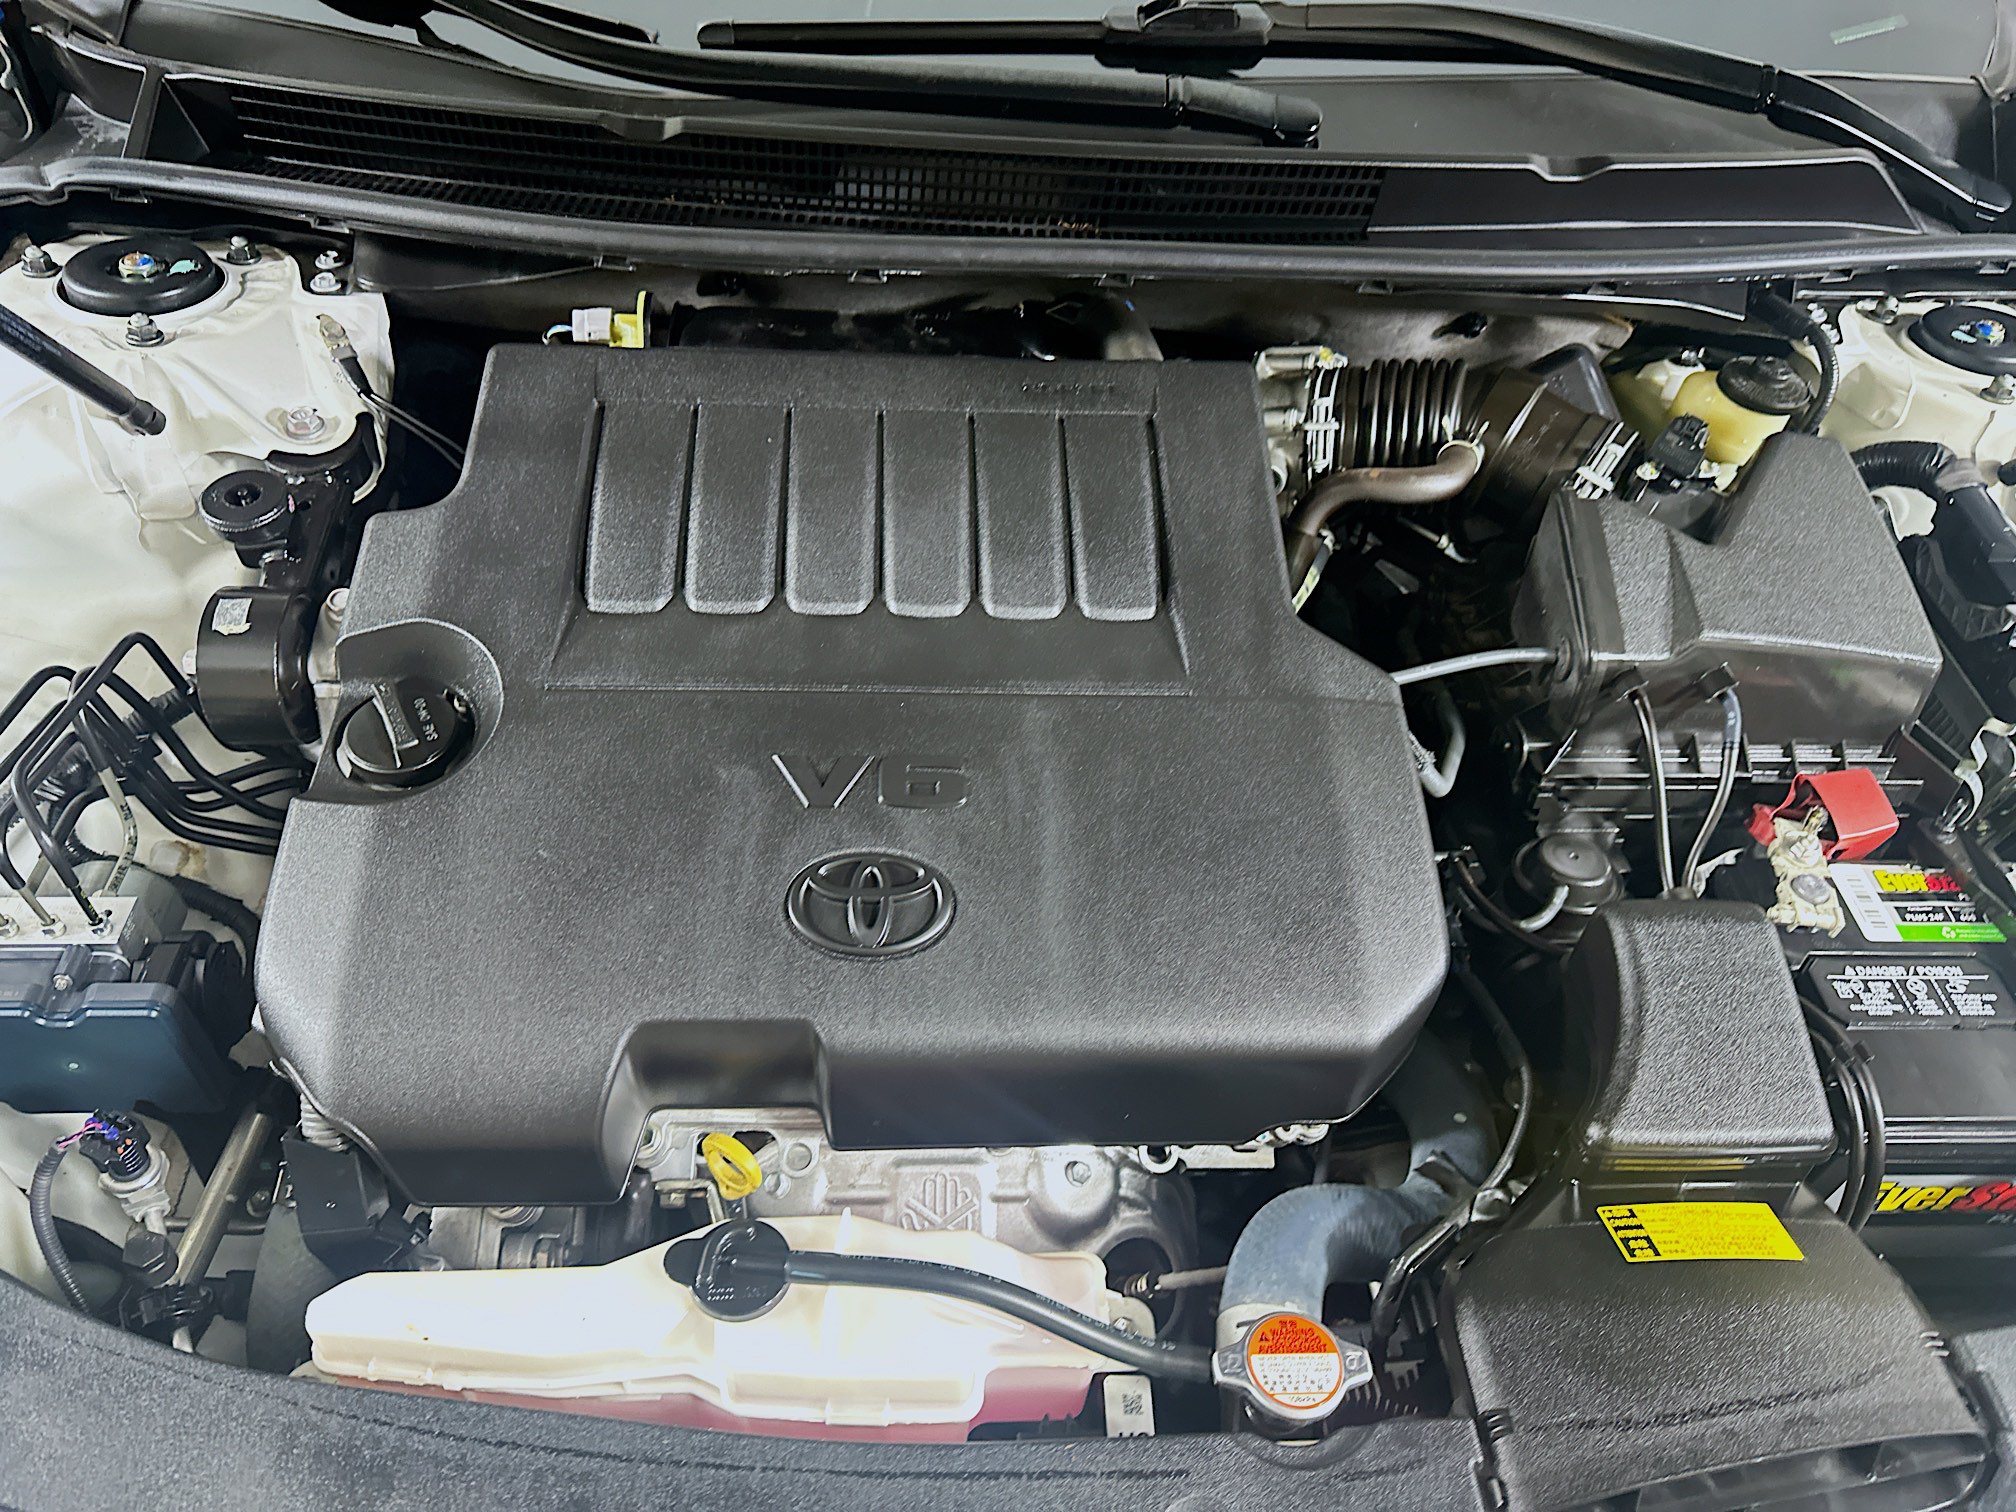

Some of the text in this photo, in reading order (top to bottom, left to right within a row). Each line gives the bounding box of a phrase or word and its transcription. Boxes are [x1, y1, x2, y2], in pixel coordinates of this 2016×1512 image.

[422, 722, 439, 741] SAE
[771, 753, 969, 809] V6
[1855, 965, 1907, 976] DANGER
[1915, 965, 1964, 976] POISON
